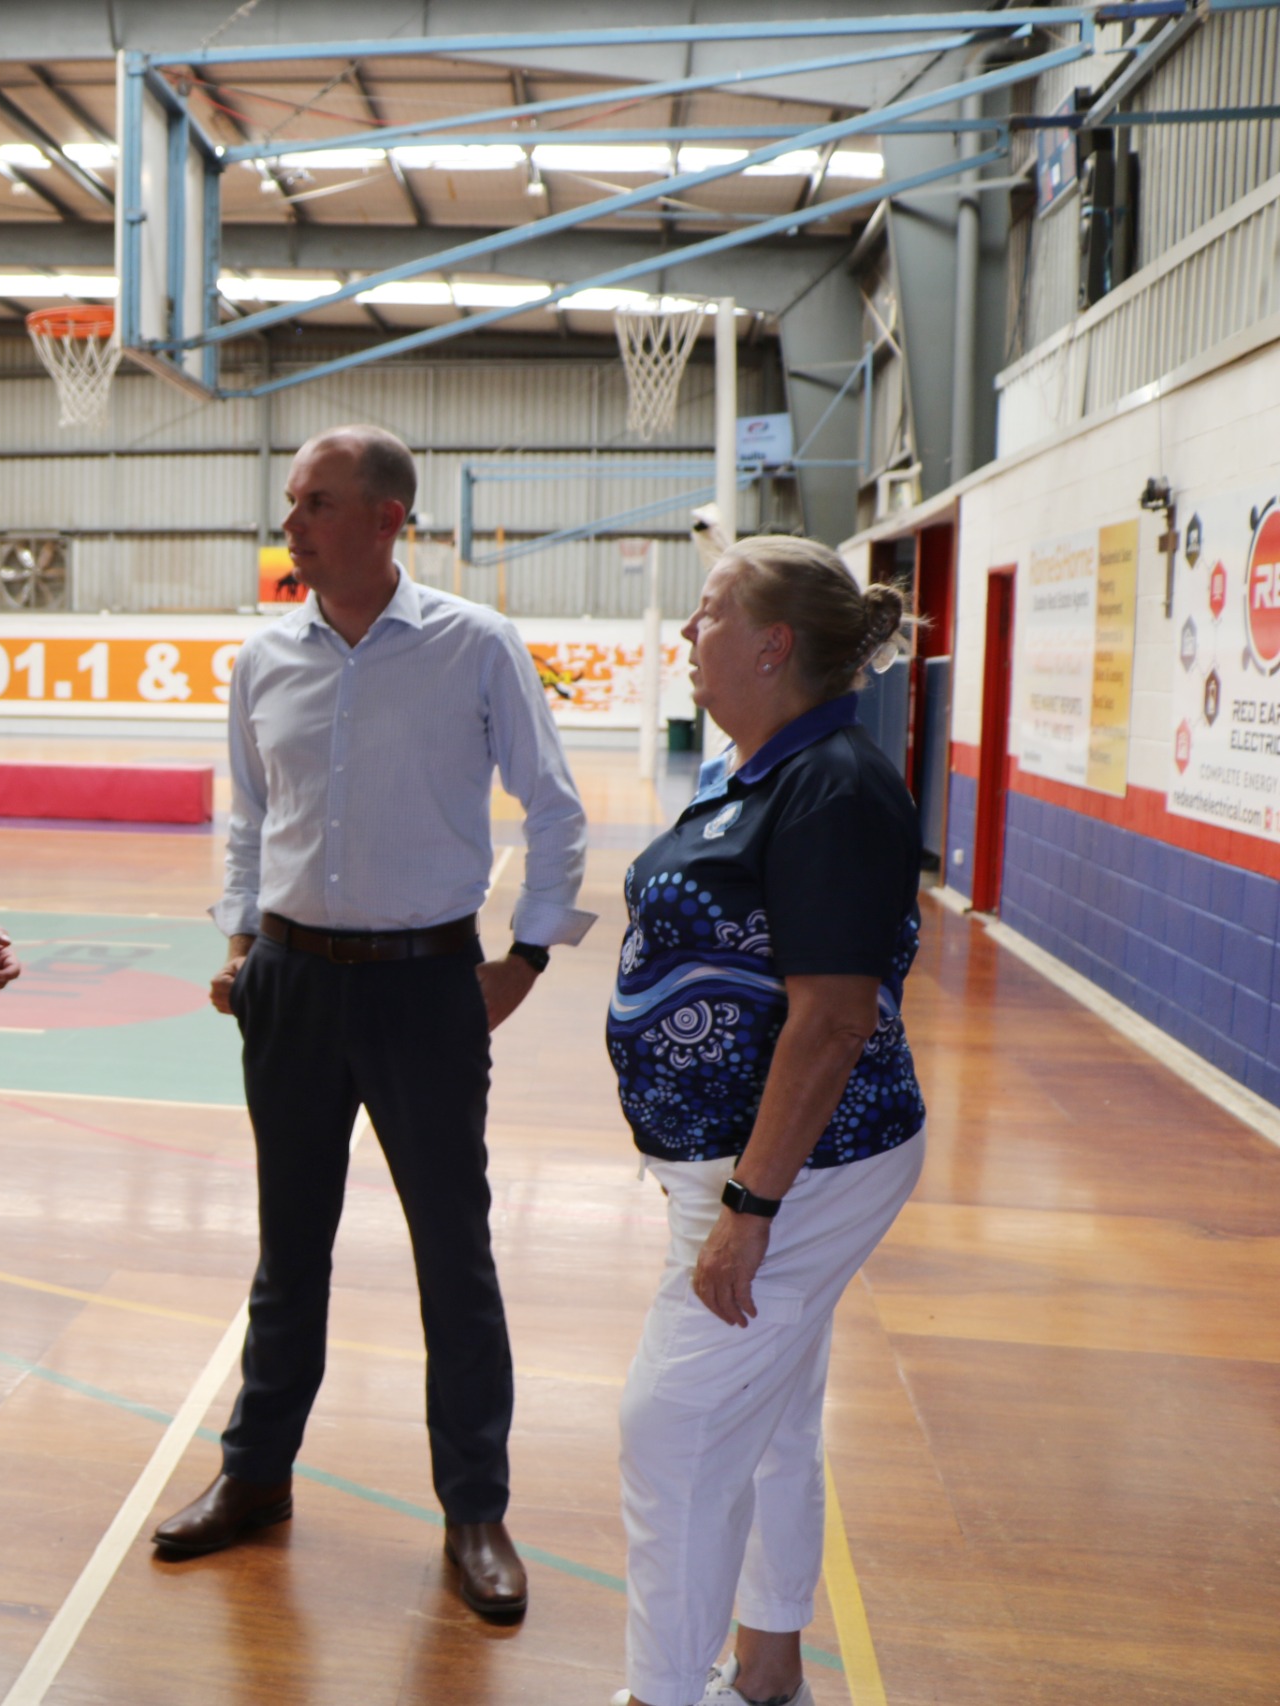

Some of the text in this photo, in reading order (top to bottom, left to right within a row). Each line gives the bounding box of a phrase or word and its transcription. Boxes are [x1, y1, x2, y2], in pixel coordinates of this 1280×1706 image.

[137, 643, 192, 701] &
[1232, 700, 1256, 723] RED
[1200, 763, 1279, 796] COMPLETE ENERGY
